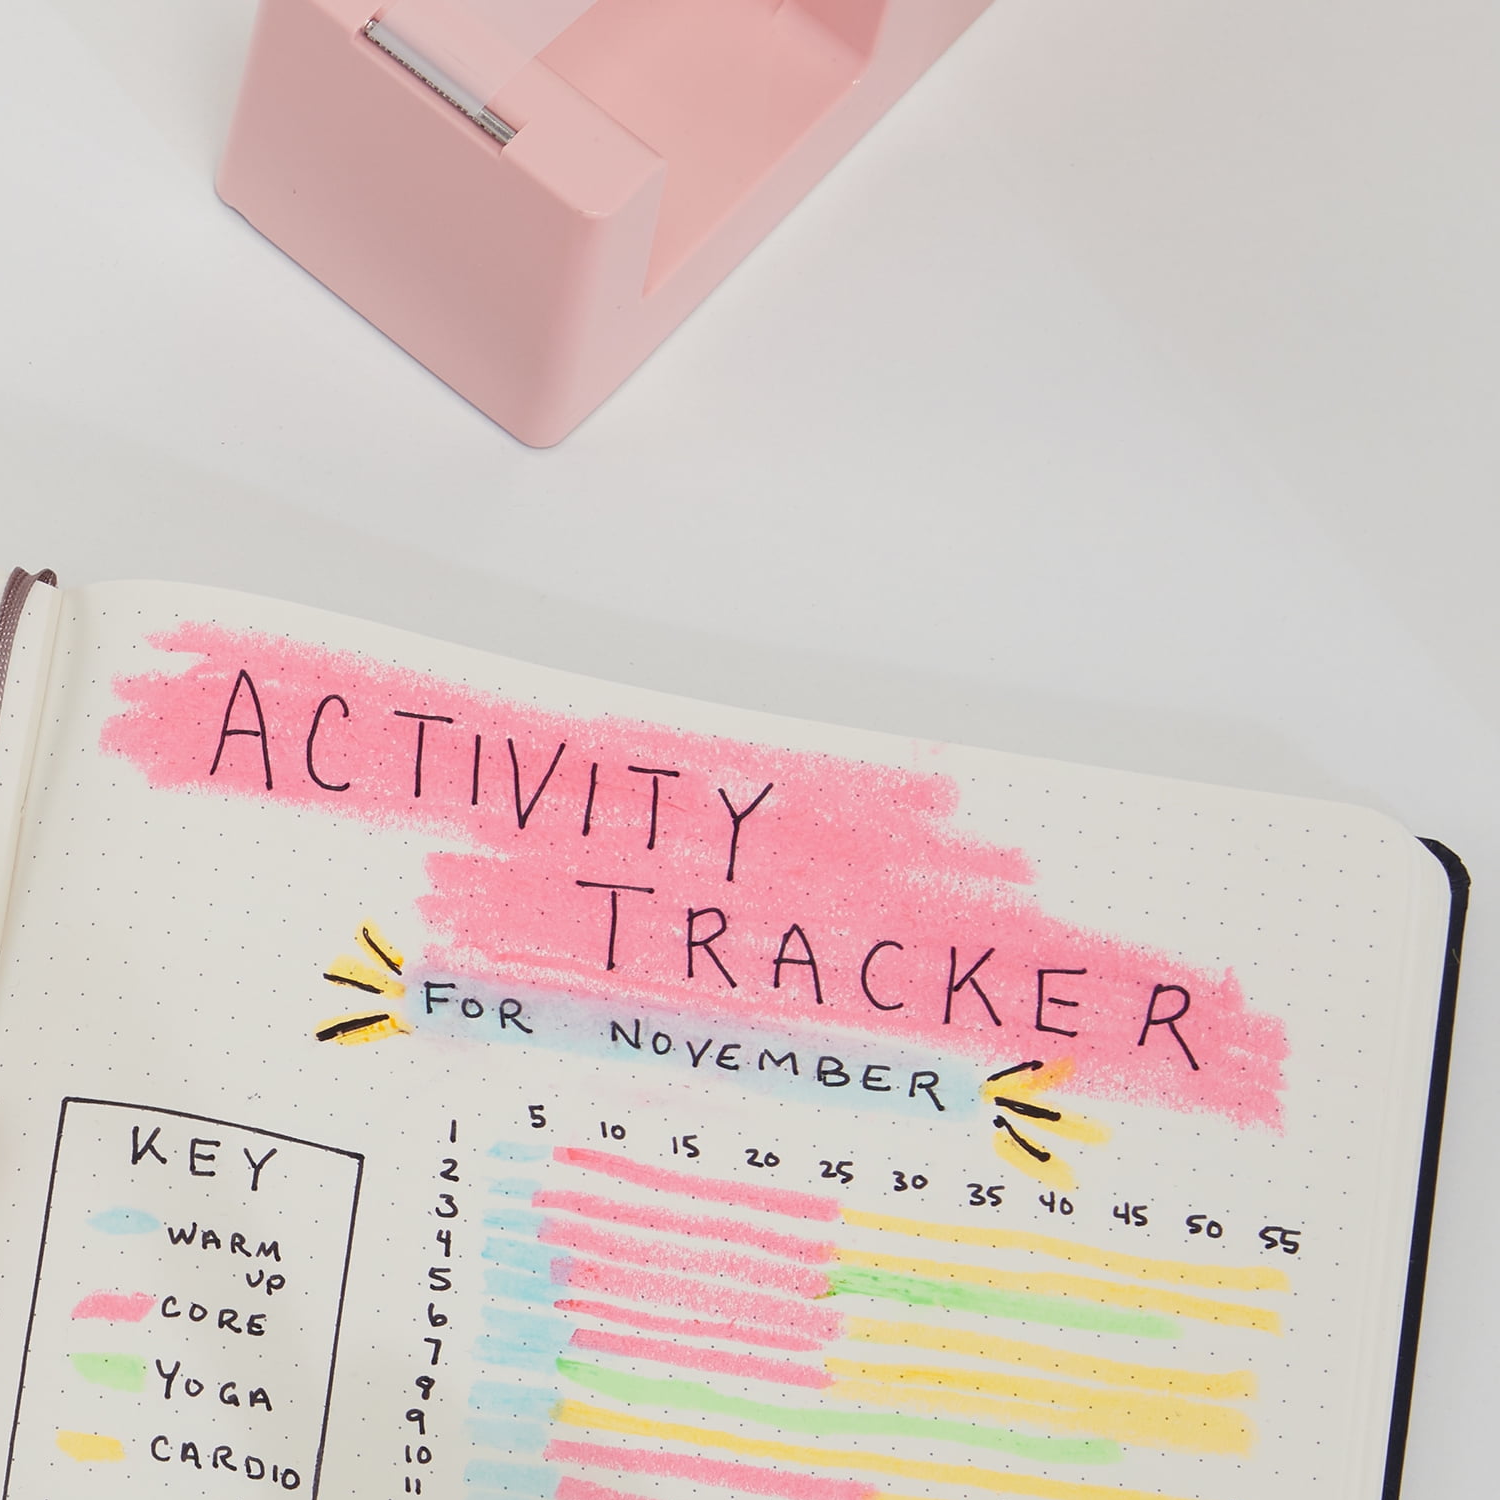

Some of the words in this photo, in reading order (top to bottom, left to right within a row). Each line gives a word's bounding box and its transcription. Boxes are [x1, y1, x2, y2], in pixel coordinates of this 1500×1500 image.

[209, 670, 774, 881] ACTIVITY
[576, 881, 1200, 1071] TRACKER
[423, 980, 534, 1035] FOR
[610, 1018, 946, 1112] NOVEMBER
[449, 1119, 457, 1144] 1
[130, 1125, 278, 1192] KEY
[439, 1158, 460, 1183] 2
[528, 1104, 547, 1129] 5
[600, 1121, 626, 1141] 10
[672, 1134, 700, 1159] 15
[744, 1148, 781, 1168] 20
[819, 1160, 854, 1185] 25
[892, 1170, 929, 1192] 30
[966, 1182, 1005, 1207] 35
[1038, 1191, 1074, 1216] 40
[1113, 1202, 1148, 1227] 45
[1185, 1214, 1223, 1239] 50
[1258, 1225, 1302, 1255] 55
[435, 1193, 459, 1219] 3
[167, 1221, 282, 1263] WARM
[436, 1229, 452, 1258] 4
[245, 1269, 286, 1296] UP
[428, 1266, 452, 1292] 5
[161, 1295, 267, 1337] CORE
[427, 1302, 448, 1328] 6
[423, 1337, 442, 1366] 7
[155, 1358, 273, 1412] YOGA
[415, 1375, 436, 1401] 8
[405, 1408, 426, 1436] 9
[150, 1435, 301, 1491] CARDIO
[405, 1444, 432, 1465] 10
[404, 1476, 422, 1496] 11
